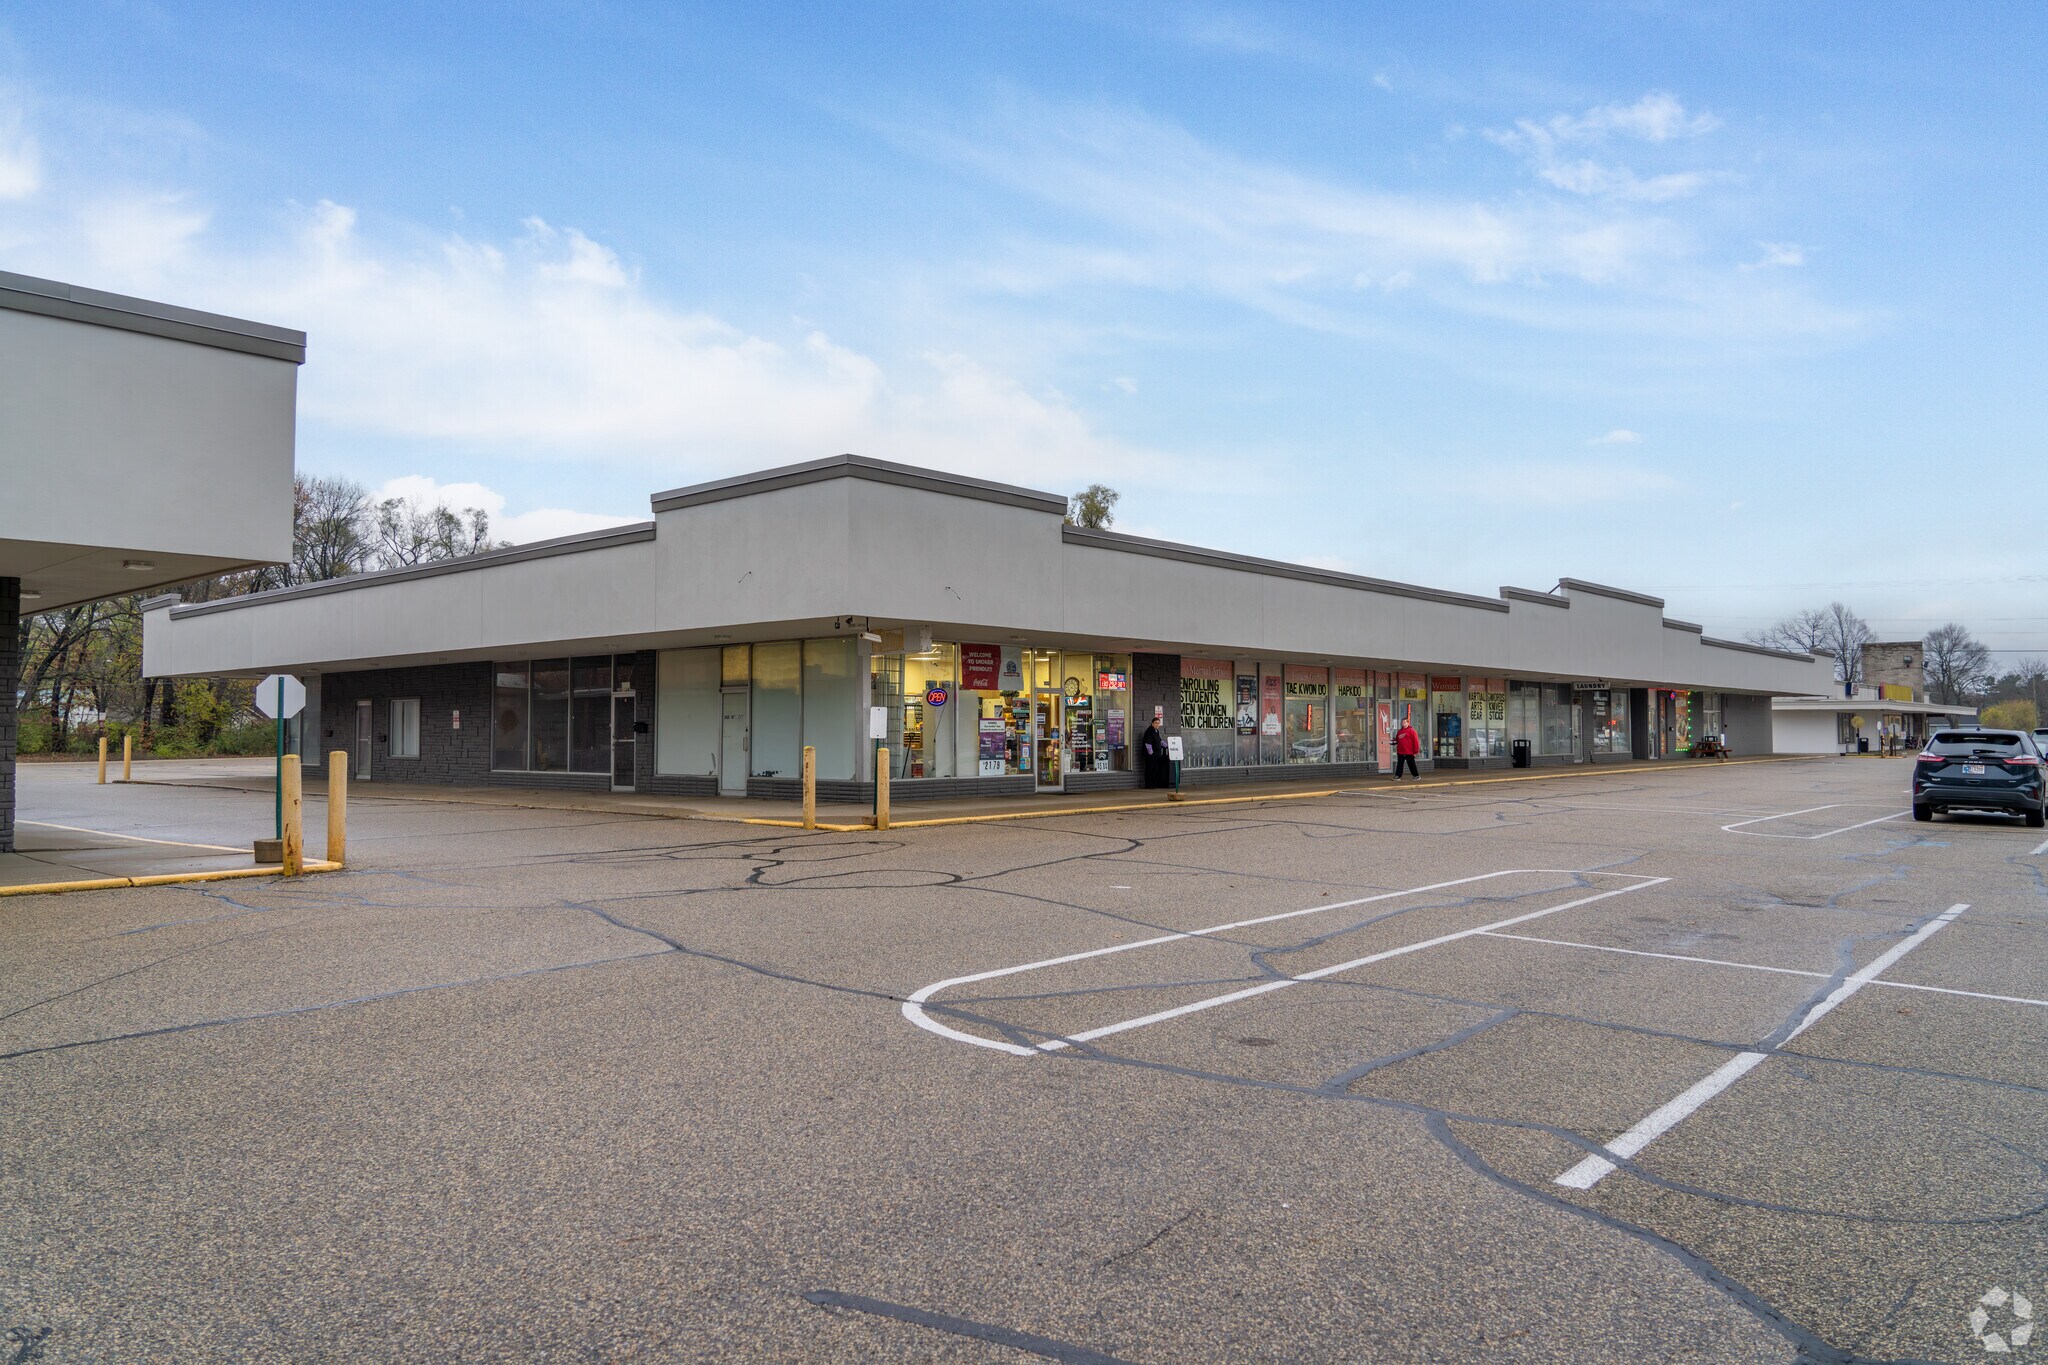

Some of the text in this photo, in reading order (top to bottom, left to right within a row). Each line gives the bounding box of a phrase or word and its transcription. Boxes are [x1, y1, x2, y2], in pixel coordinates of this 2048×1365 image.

[1181, 677, 1219, 691] ENROLLING
[1286, 682, 1327, 695] TAE KWON DO
[928, 692, 946, 702] OPEN
[1181, 690, 1219, 704] STUDENTS
[1338, 686, 1361, 697] HAPKIDO
[1181, 703, 1226, 716] MEN WOMEN
[1471, 702, 1482, 711] ARTS
[1471, 711, 1482, 720] GEAR
[1489, 711, 1503, 720] STICKS
[1181, 716, 1235, 728] AND CHILDREN
